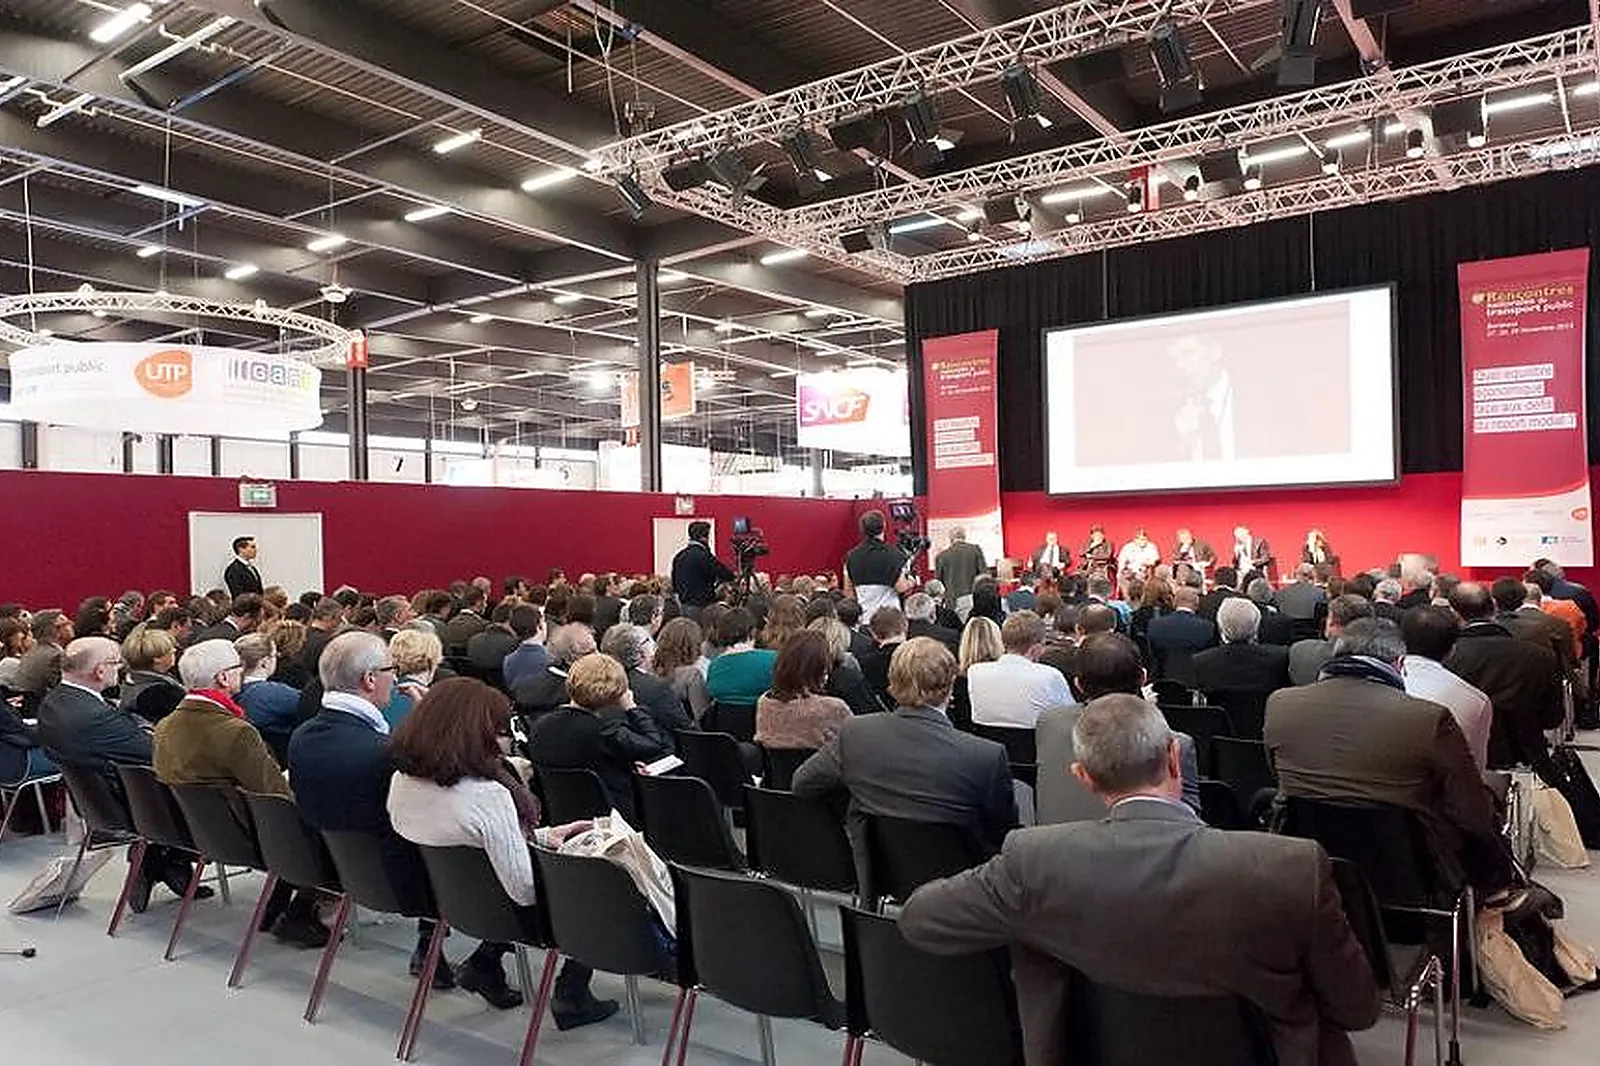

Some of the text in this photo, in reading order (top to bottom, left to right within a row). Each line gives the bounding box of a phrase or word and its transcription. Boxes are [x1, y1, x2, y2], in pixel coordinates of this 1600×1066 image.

[1487, 286, 1574, 302] Rencontres
[1487, 300, 1574, 317] transport public
[145, 362, 187, 381] UTP
[801, 394, 867, 422] SNCF
